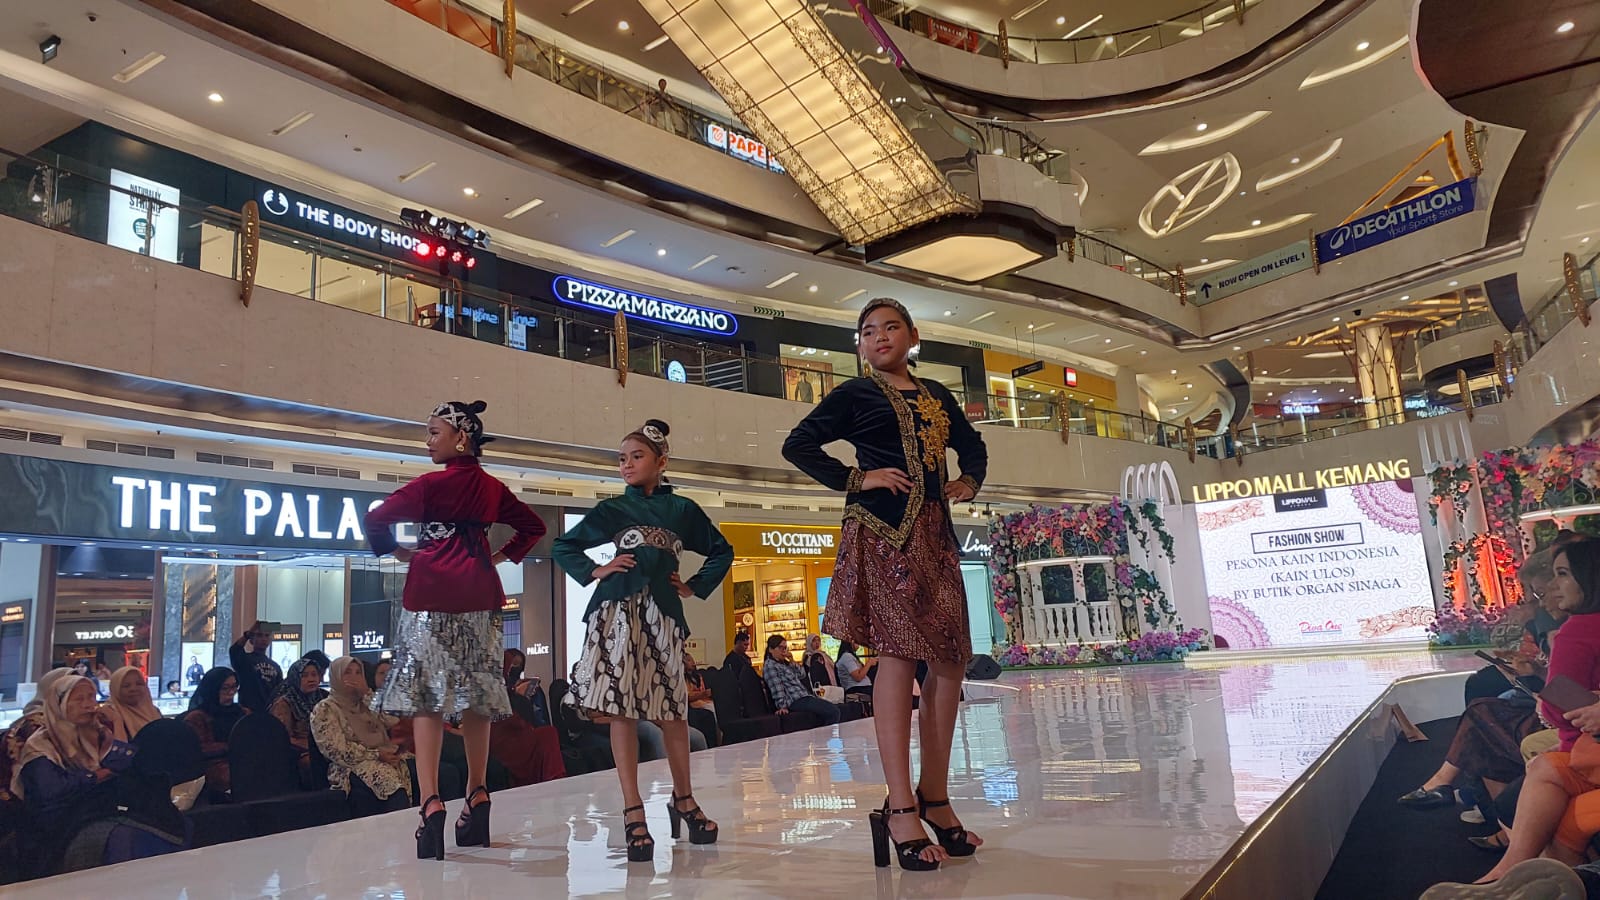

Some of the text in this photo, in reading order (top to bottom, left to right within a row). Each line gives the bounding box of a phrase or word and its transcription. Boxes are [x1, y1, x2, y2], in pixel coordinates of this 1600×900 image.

[729, 133, 774, 162] PAPE
[296, 201, 330, 225] THE
[333, 213, 378, 239] BODY
[1353, 187, 1461, 240] DECATHLON
[1439, 203, 1463, 220] Store
[1218, 275, 1237, 290] NOW
[1238, 268, 1260, 282] OPEN
[1261, 263, 1273, 274] ON
[1273, 255, 1300, 270] LEVEL
[1192, 459, 1411, 503] LIPPO MALL KEMANG
[112, 476, 418, 543] THE PALAE
[1268, 529, 1345, 547] FASHION SHOW
[1226, 545, 1400, 571] PESONA KAIN INDONESIA
[1234, 577, 1401, 600] BY BUTIK ORGAN SINAGA
[1271, 566, 1355, 583] (KAIN ULOS)
